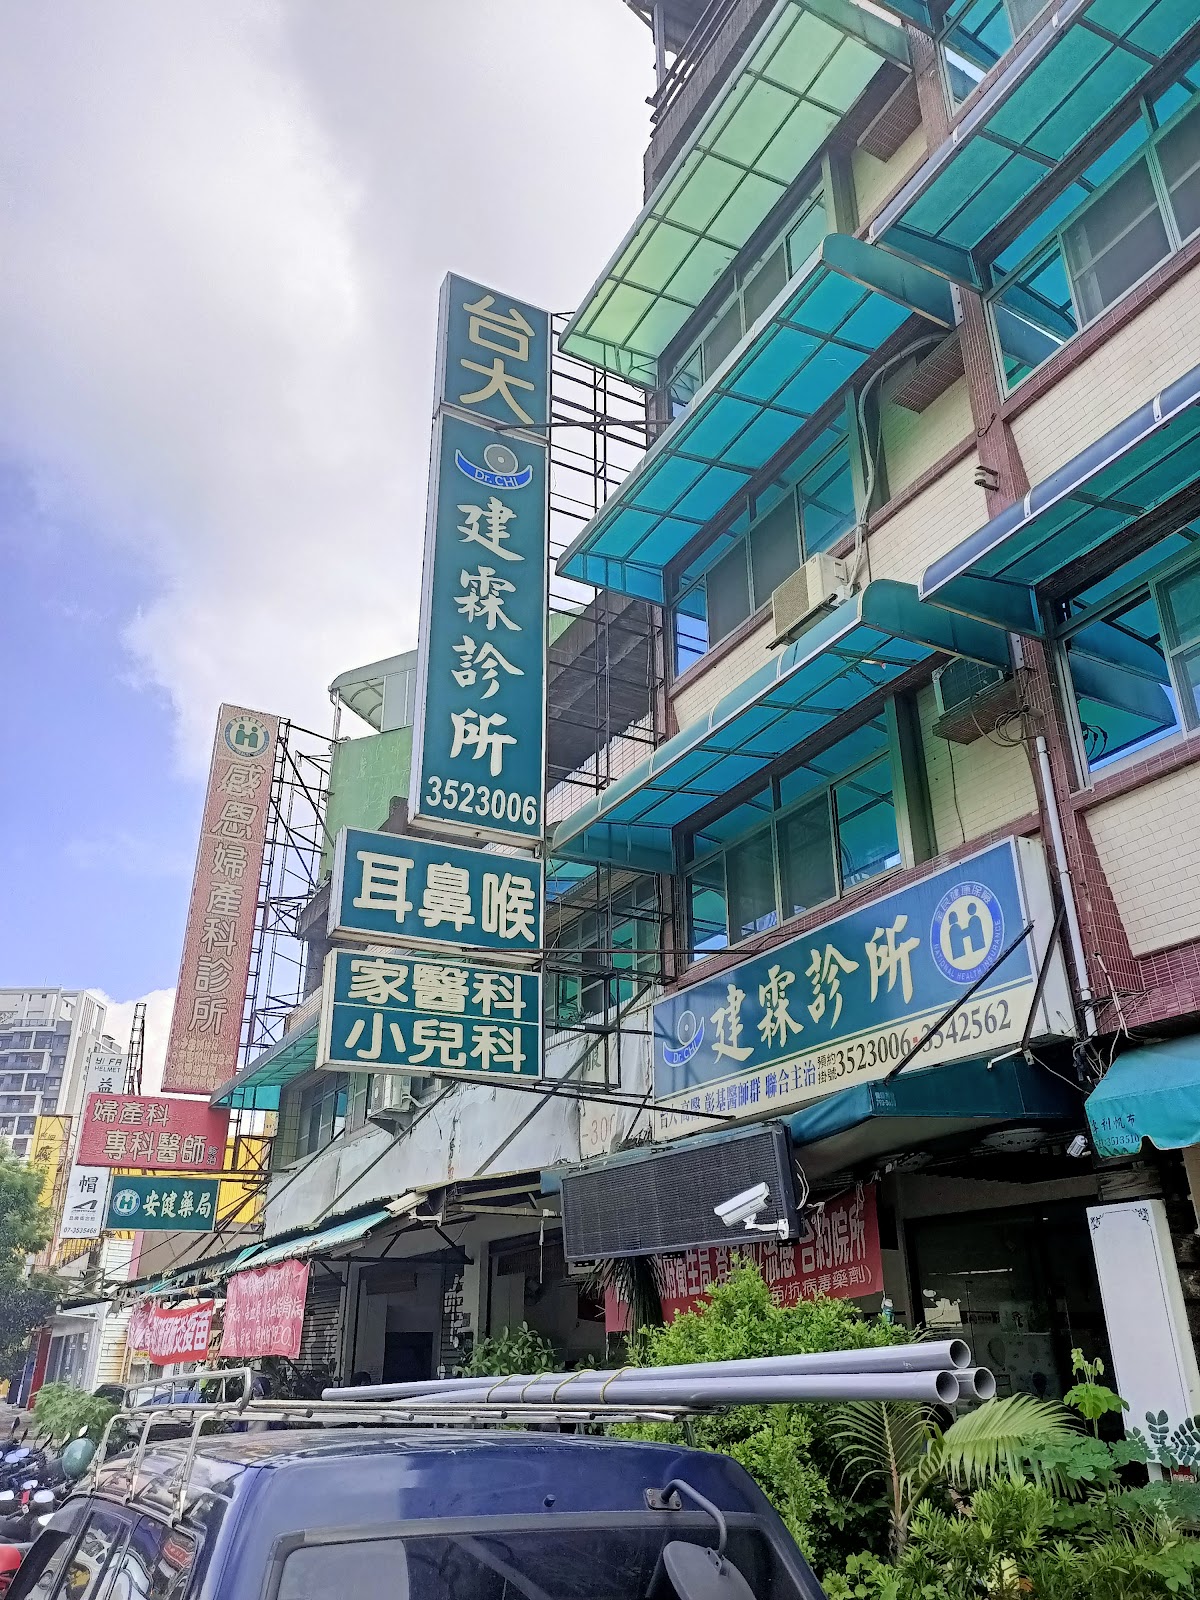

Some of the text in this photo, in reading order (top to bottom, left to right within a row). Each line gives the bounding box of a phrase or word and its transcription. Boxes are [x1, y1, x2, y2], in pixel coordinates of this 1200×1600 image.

[459, 294, 536, 425] 台大
[474, 469, 519, 488] Dr. CHI
[450, 496, 525, 778] 建霖診所
[425, 775, 538, 827] 3523006
[353, 850, 536, 943] 耳鼻喉
[348, 958, 527, 1019] 家醫科
[710, 914, 921, 1065] 建霖診所
[957, 968, 983, 981] HEALTH
[344, 1013, 527, 1073] 小兒科
[673, 1043, 700, 1063] Dr. CHI
[817, 1052, 836, 1070] 預約
[836, 1027, 911, 1077] 3523006
[91, 1099, 170, 1127] 婦產科
[102, 1129, 208, 1166] 專科醫師
[79, 1174, 99, 1194] 帽
[142, 1189, 212, 1219] 安健藥局
